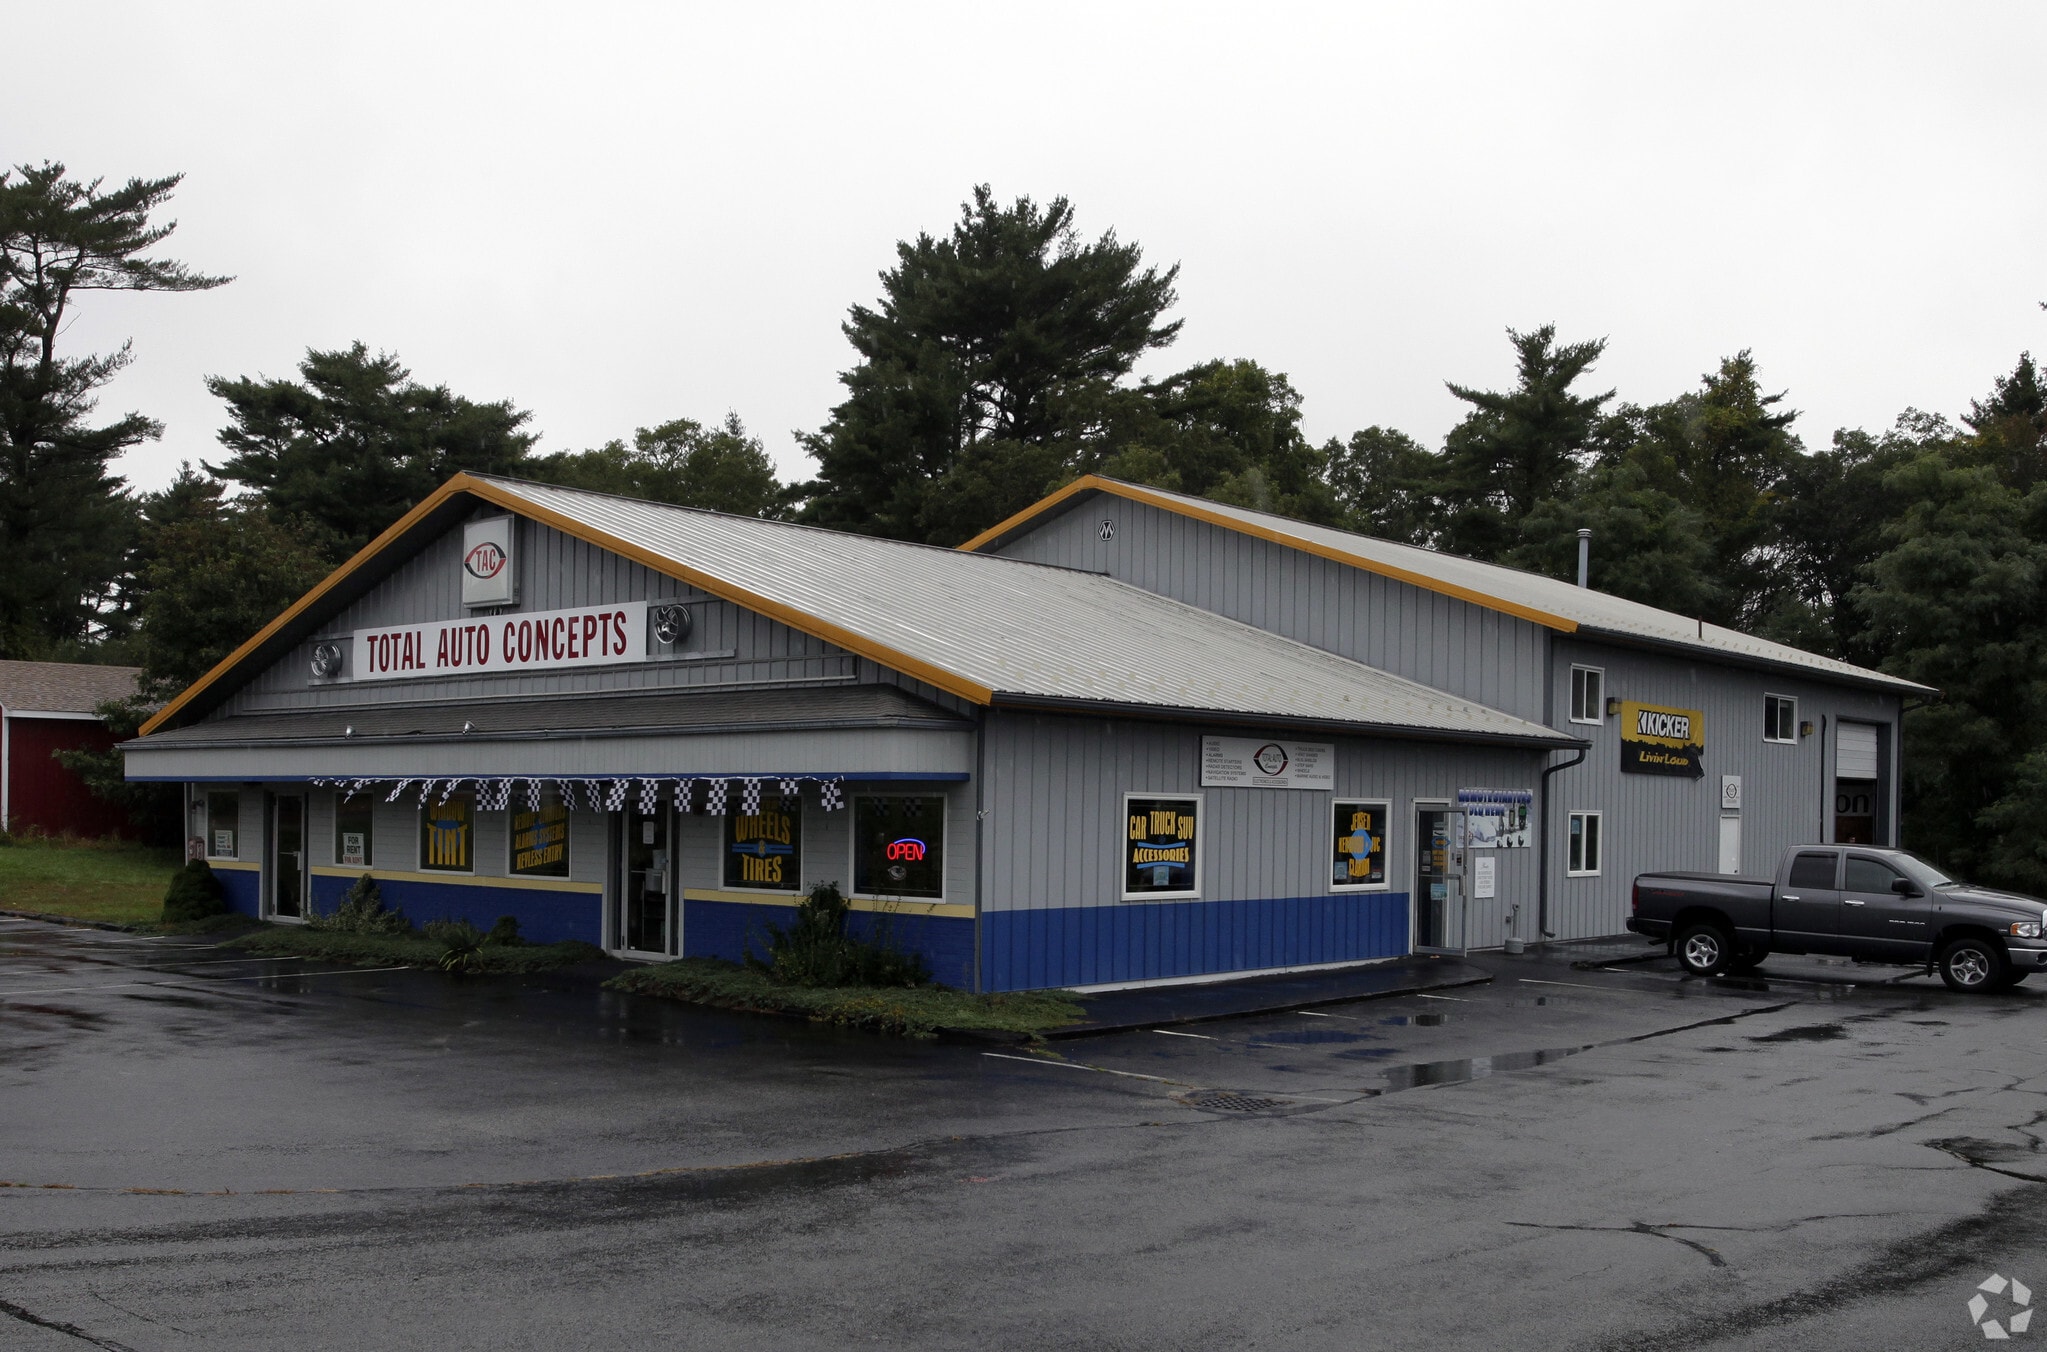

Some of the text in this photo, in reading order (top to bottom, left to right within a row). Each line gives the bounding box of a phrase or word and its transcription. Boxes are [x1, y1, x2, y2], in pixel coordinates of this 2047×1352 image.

[475, 549, 497, 572] TAC
[367, 610, 627, 673] TOTAL AUTO CONCEPTS
[1646, 711, 1690, 739] KICKER
[735, 811, 791, 845] WHEELS
[1130, 810, 1194, 840] CAR TRUCK SUV
[347, 845, 361, 854] RENT
[348, 836, 359, 844] FOR
[426, 822, 468, 866] TINT
[758, 839, 766, 856] &
[886, 842, 924, 861] OPEN
[742, 852, 783, 883] TIRES
[1132, 847, 1190, 863] ACCESSORIES
